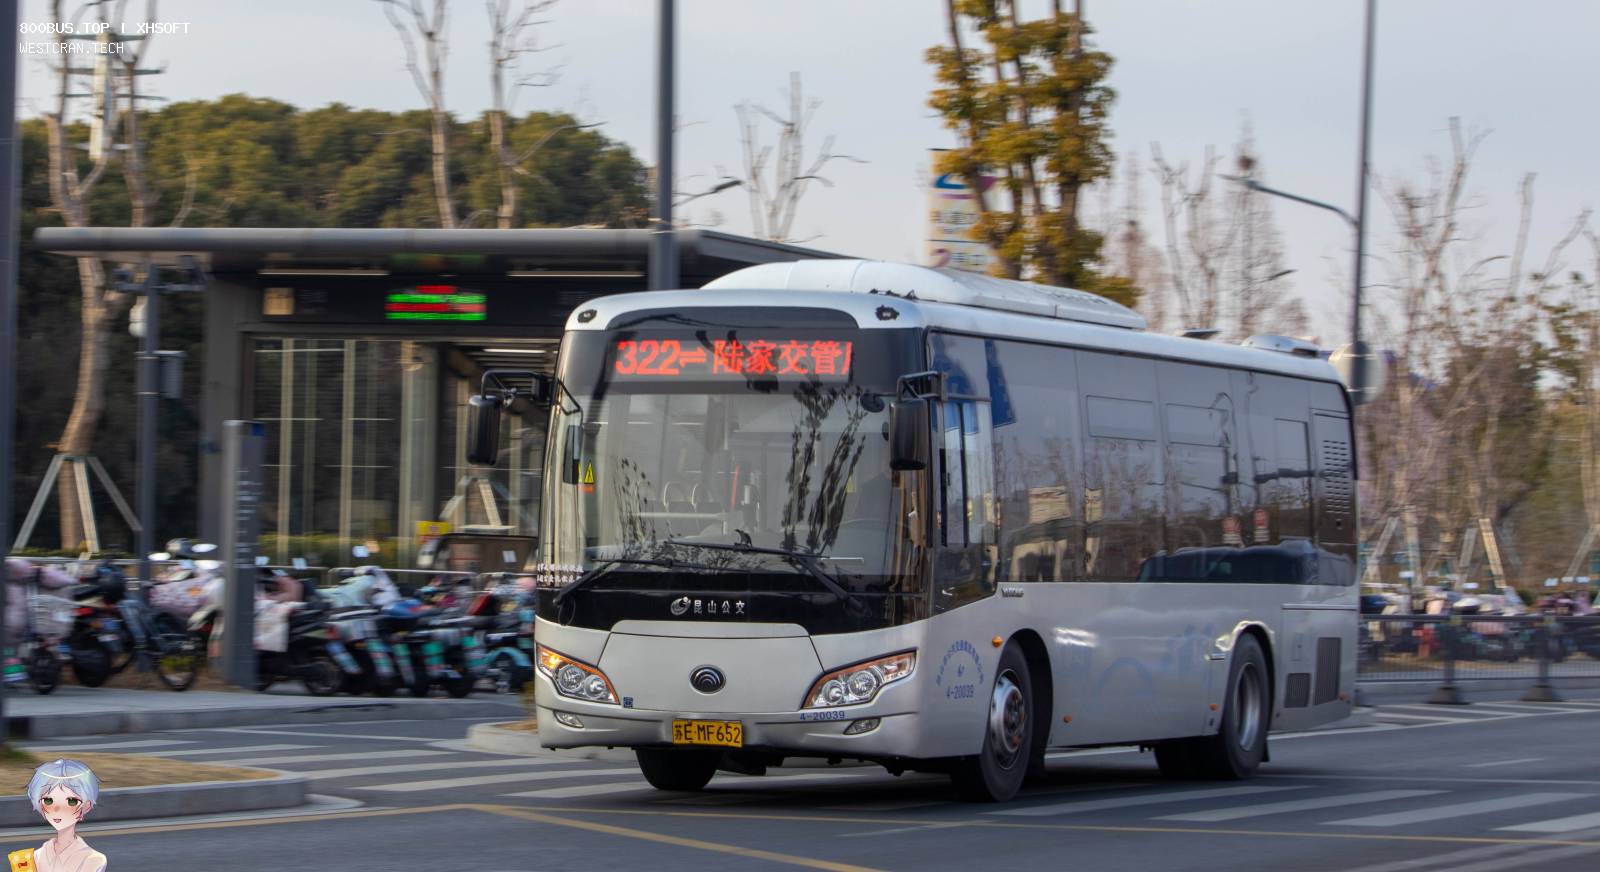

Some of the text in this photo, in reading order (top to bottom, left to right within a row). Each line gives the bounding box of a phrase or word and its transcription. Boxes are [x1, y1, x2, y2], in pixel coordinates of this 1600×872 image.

[615, 340, 681, 376] 322
[694, 600, 746, 614] 昆山公交
[800, 711, 845, 721] 4-20039
